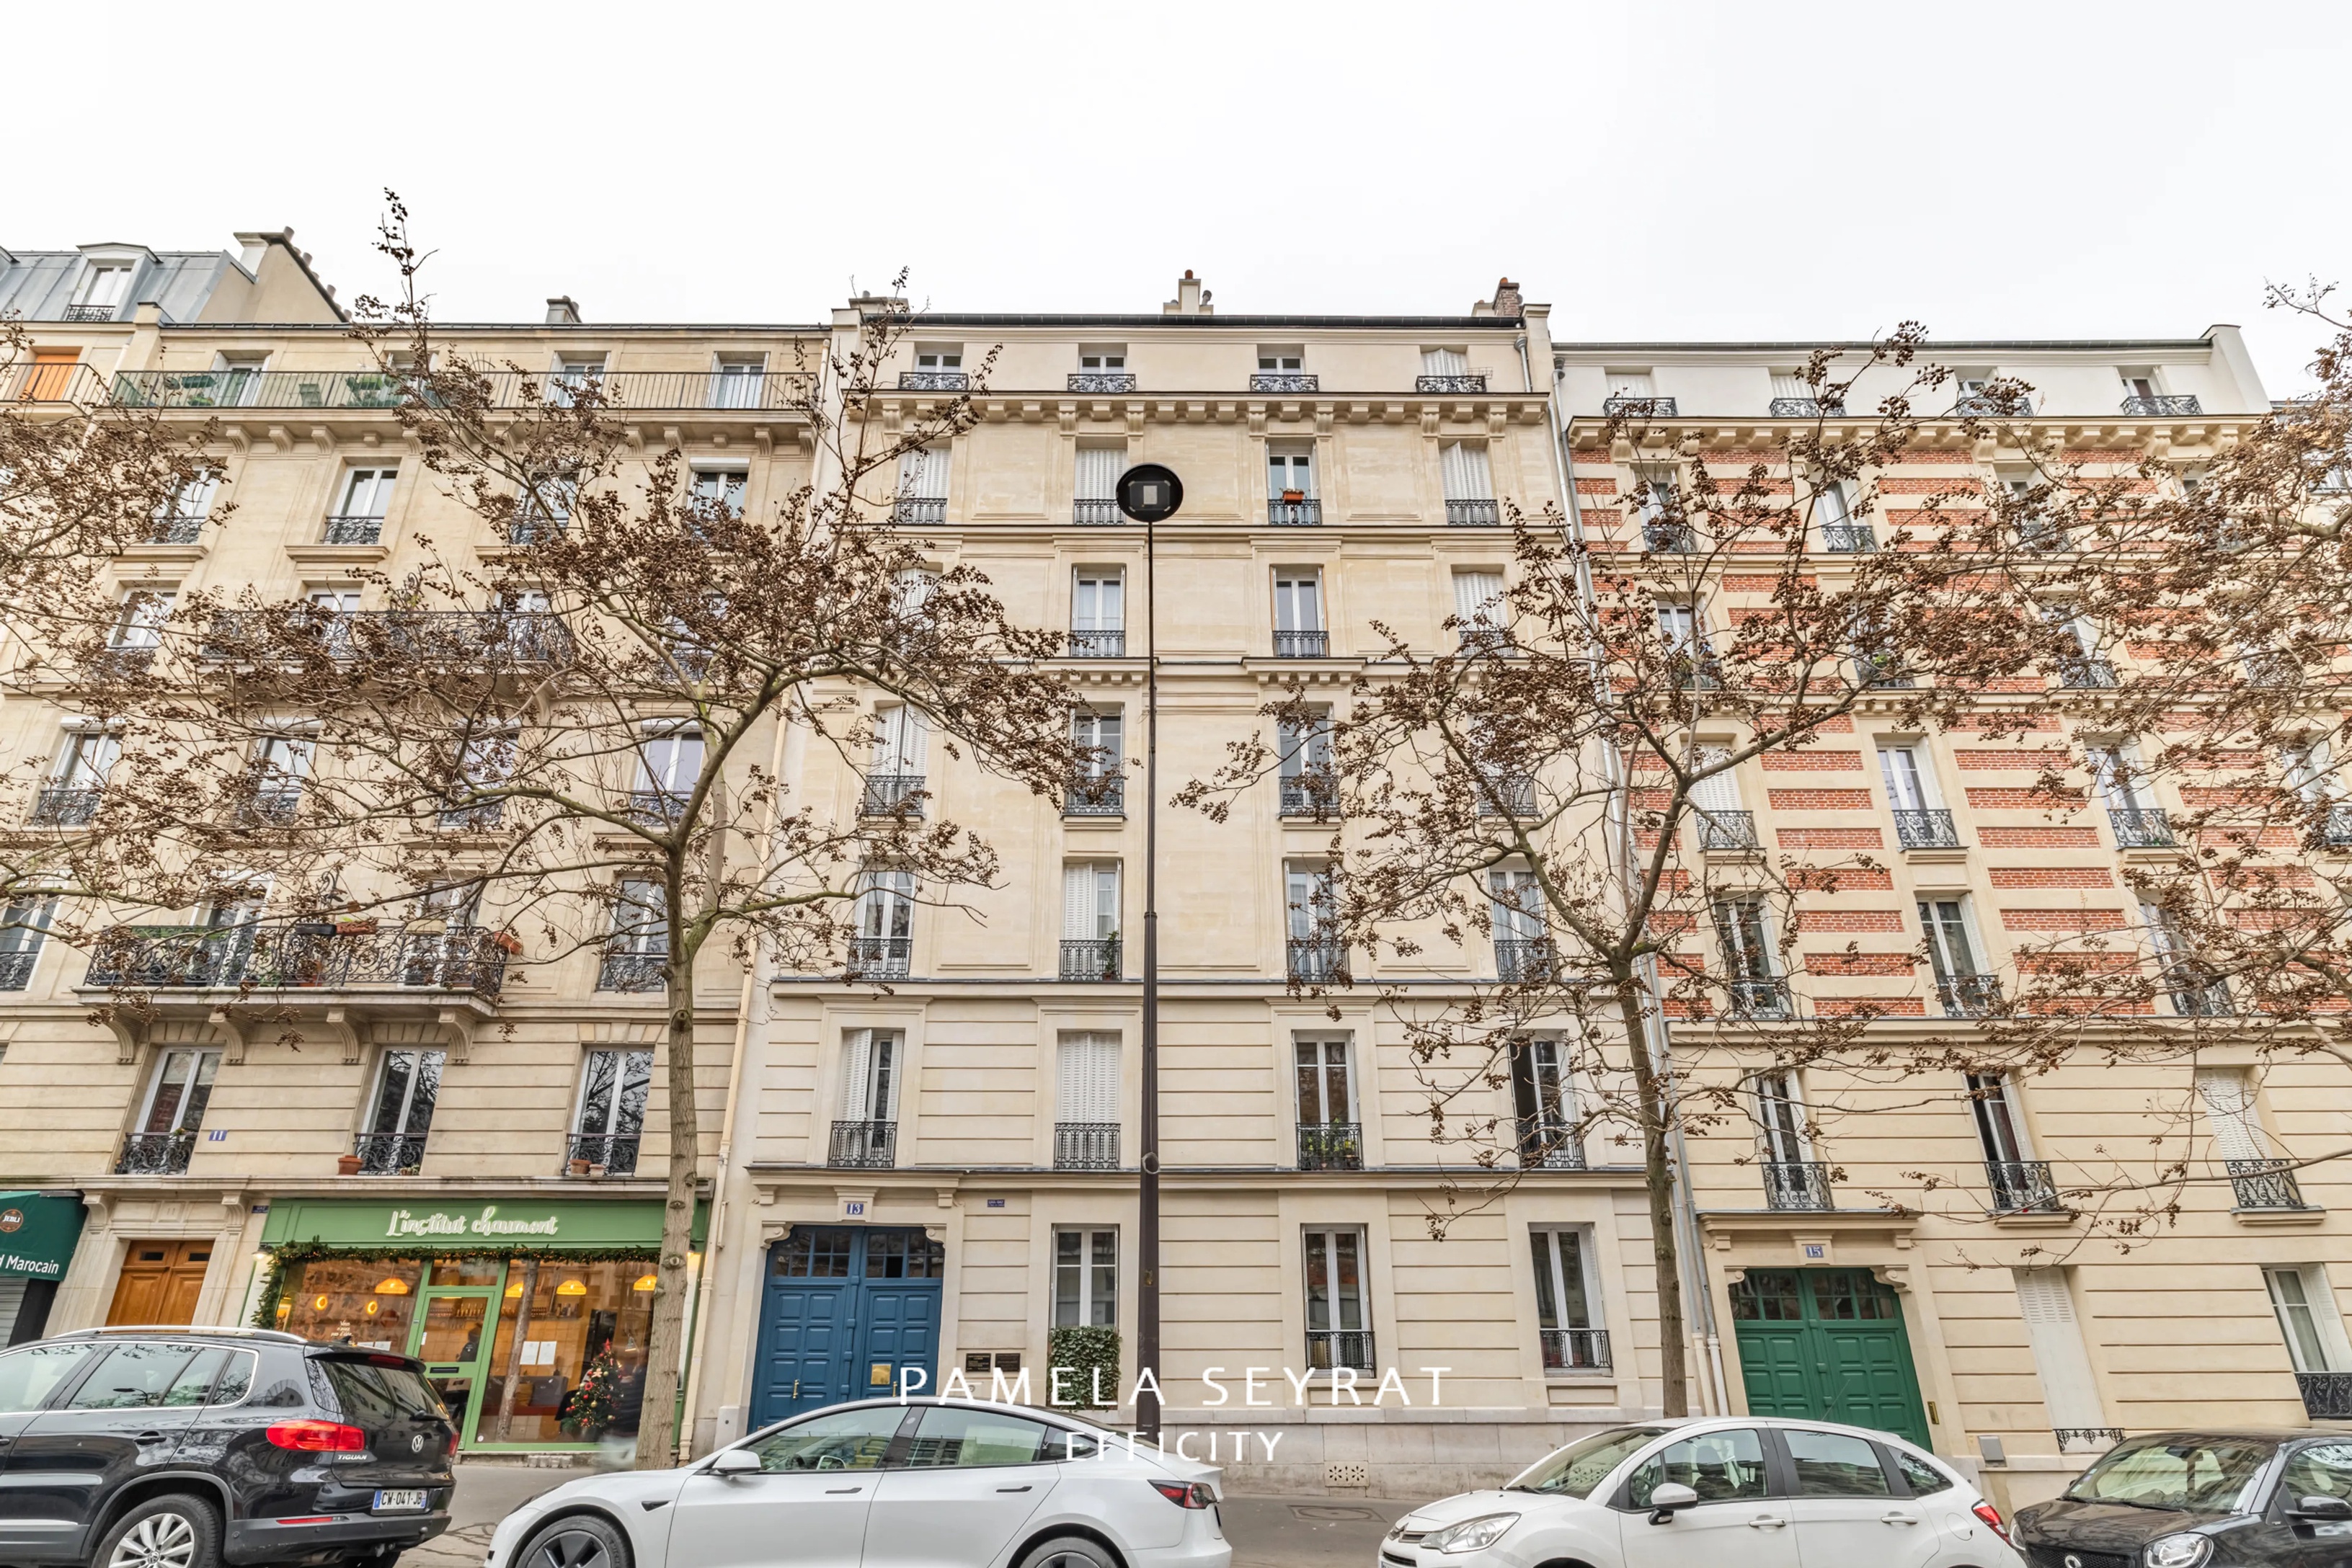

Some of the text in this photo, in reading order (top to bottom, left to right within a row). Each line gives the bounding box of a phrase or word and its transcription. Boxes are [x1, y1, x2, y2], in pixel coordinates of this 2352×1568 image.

[212, 1131, 223, 1141] 11
[850, 1203, 861, 1214] 13
[386, 1206, 559, 1237] L'institut chaumont
[1809, 1247, 1821, 1257] 15
[5, 1255, 60, 1275] Marocain
[381, 1491, 422, 1506] CW-041-JB
